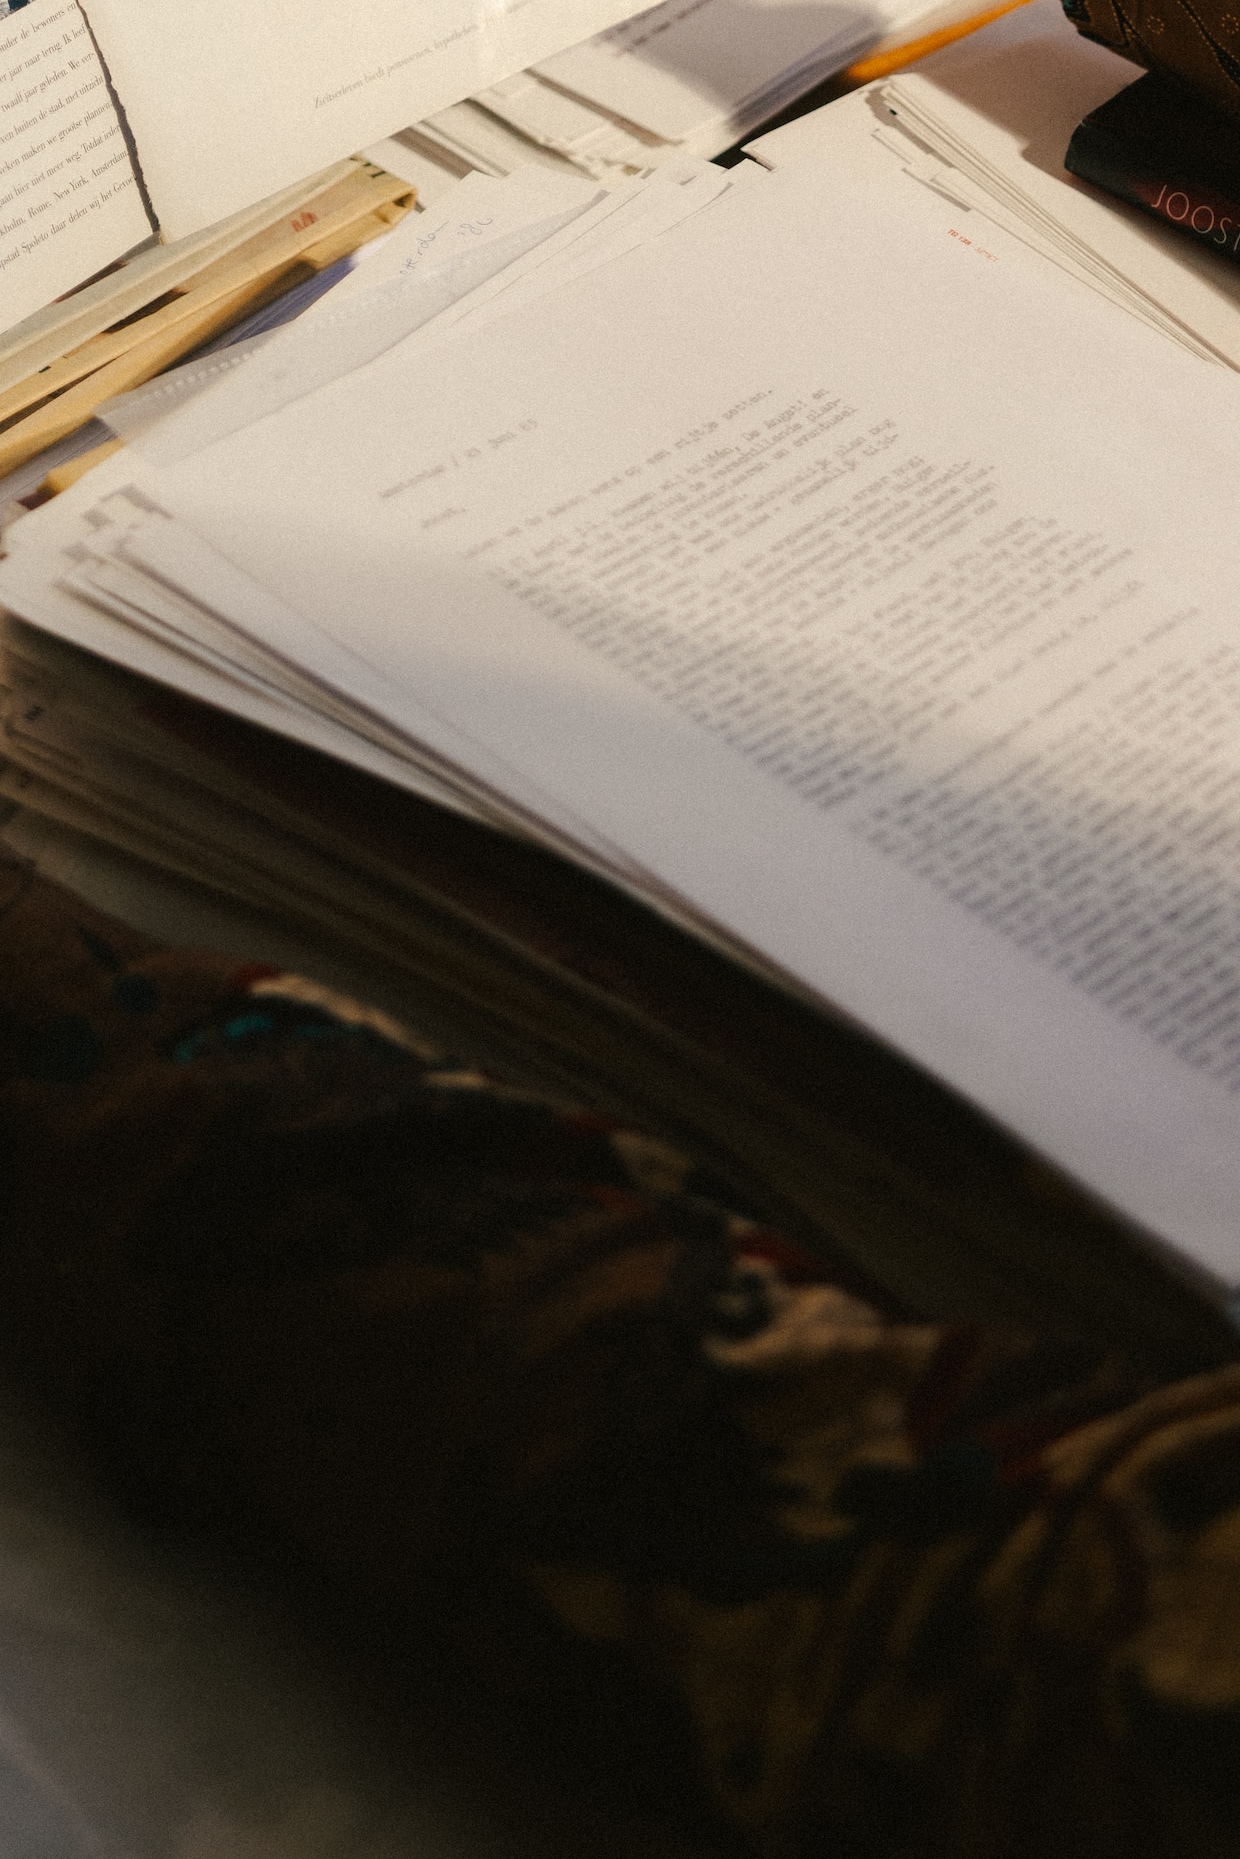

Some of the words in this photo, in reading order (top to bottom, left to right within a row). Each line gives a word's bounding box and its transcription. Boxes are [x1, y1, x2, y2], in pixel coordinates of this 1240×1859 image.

[19, 29, 30, 39] de
[31, 9, 65, 32] bewoners
[66, 2, 76, 12] en
[8, 64, 22, 80] jaar
[24, 53, 40, 67] naar
[41, 42, 62, 57] terug.
[62, 32, 71, 44] Ik
[72, 24, 86, 38] leef
[0, 91, 22, 111] twaalf
[23, 85, 38, 101] jaar
[38, 69, 68, 92] geleden.
[67, 60, 80, 71] We
[81, 52, 94, 64] ver-
[13, 116, 38, 134] buiten
[37, 109, 48, 120] de
[48, 98, 65, 114] stad,
[65, 90, 78, 104] met
[79, 74, 104, 95] uitzicht
[13, 182, 29, 195] hier
[30, 170, 45, 185] niet
[46, 160, 63, 175] meer
[65, 151, 81, 163] weg.
[80, 135, 102, 153] Totdat
[103, 124, 121, 139] ieder
[21, 142, 45, 161] maken
[46, 135, 57, 145] we
[58, 119, 83, 142] grootse
[20, 231, 48, 253] Spoleto
[49, 220, 66, 234] daar
[67, 206, 87, 222] delen
[88, 197, 100, 209] wij
[100, 188, 112, 201] het
[27, 200, 52, 217] Rome,
[53, 187, 69, 201] New
[69, 174, 89, 191] York,
